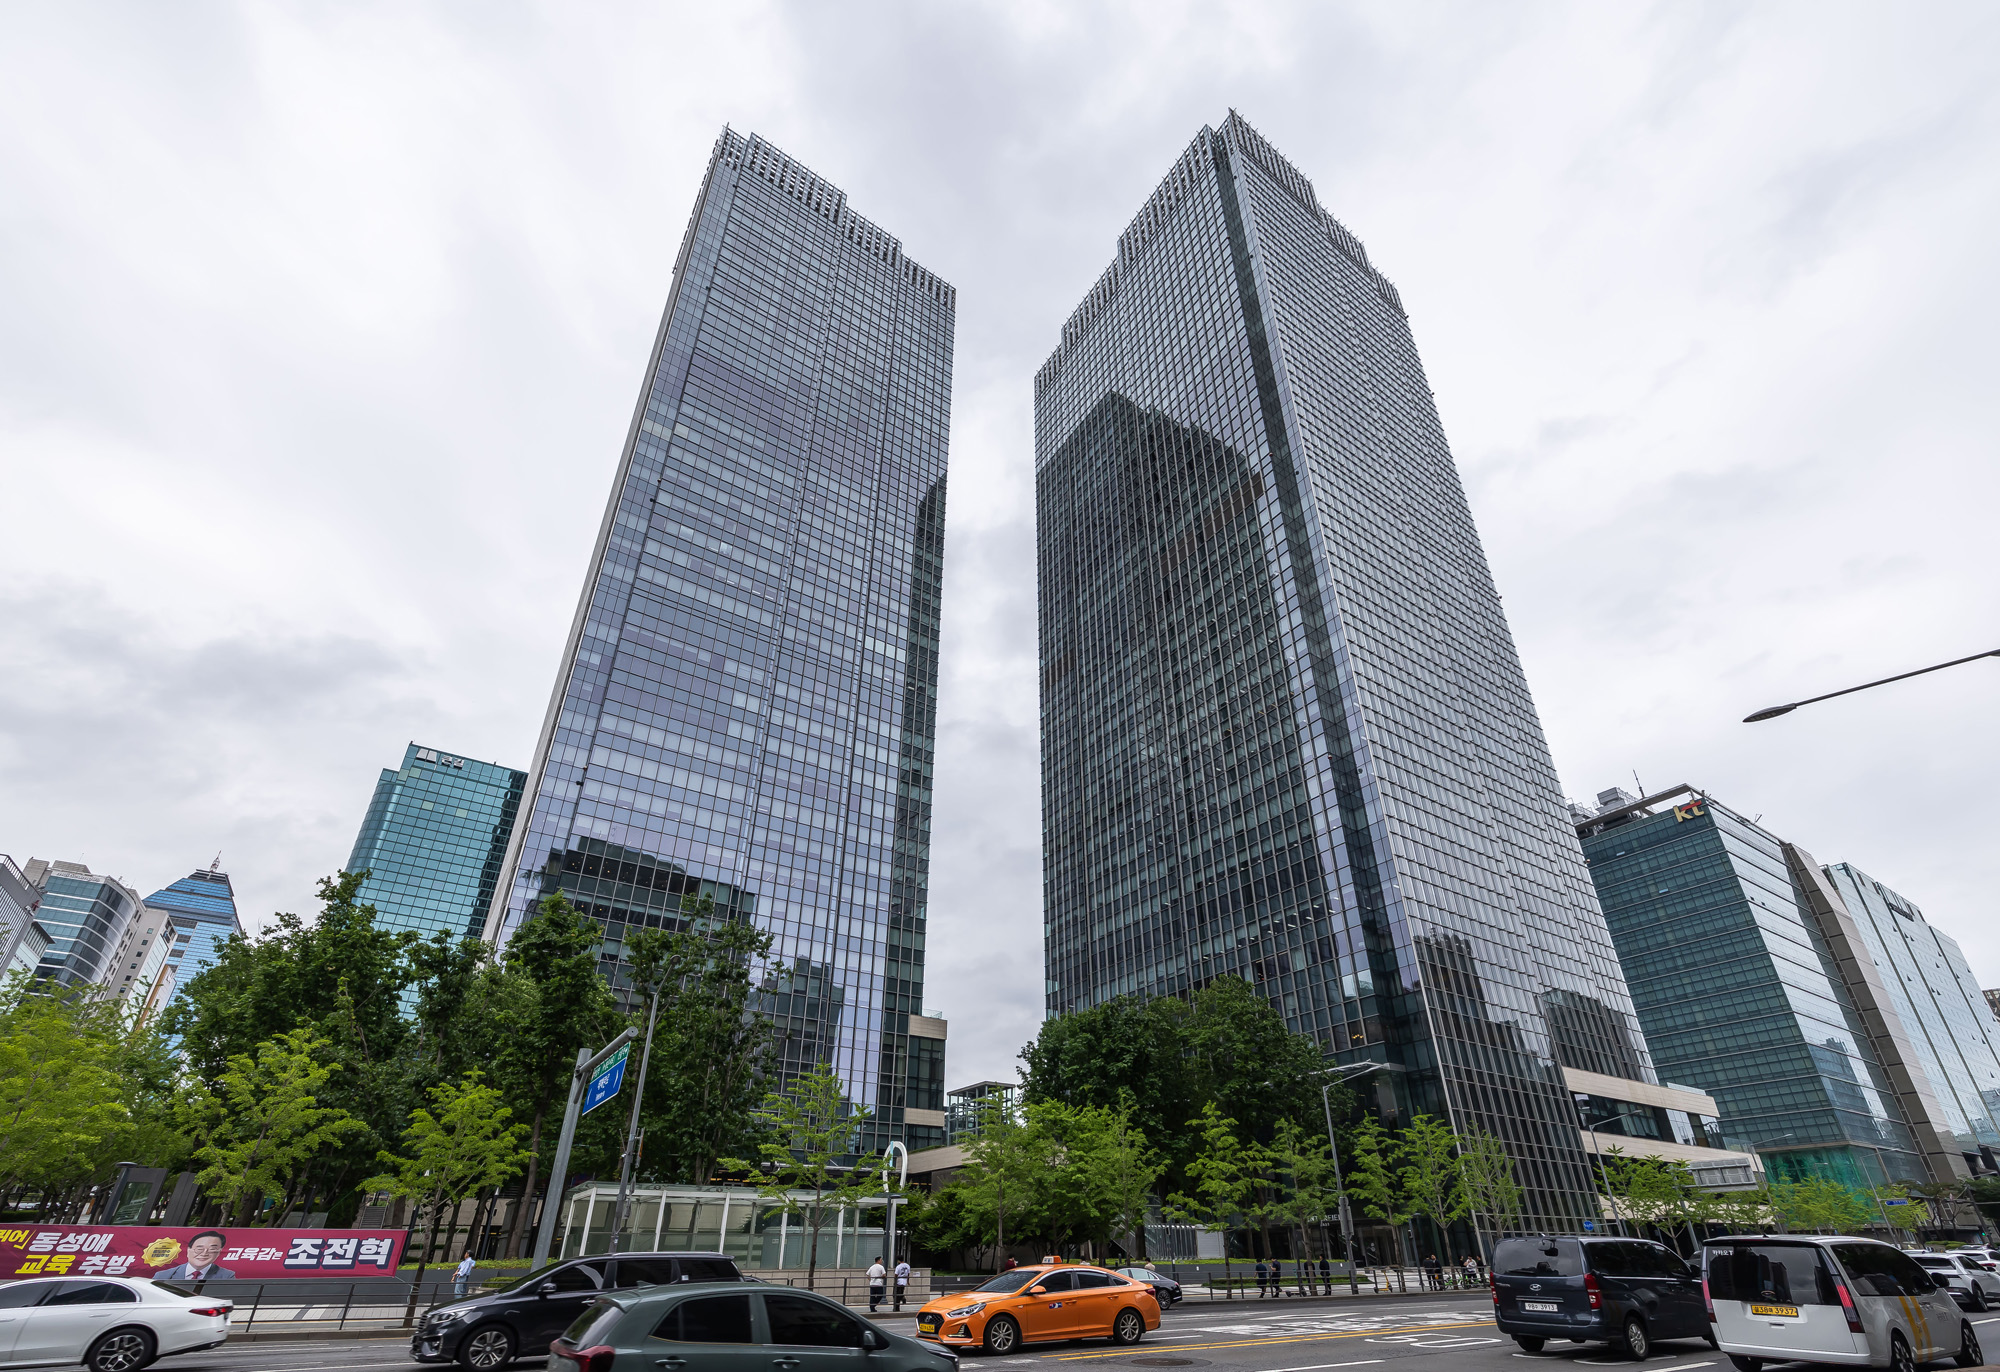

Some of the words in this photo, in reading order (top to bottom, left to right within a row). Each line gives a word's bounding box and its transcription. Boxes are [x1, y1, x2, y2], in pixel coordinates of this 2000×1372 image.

[1673, 800, 1704, 822] kt
[28, 1232, 114, 1252] 동성애
[284, 1237, 393, 1266] 조전혁
[14, 1254, 76, 1274] 교육
[78, 1254, 136, 1275] 추방
[1775, 1307, 1794, 1315] 3937
